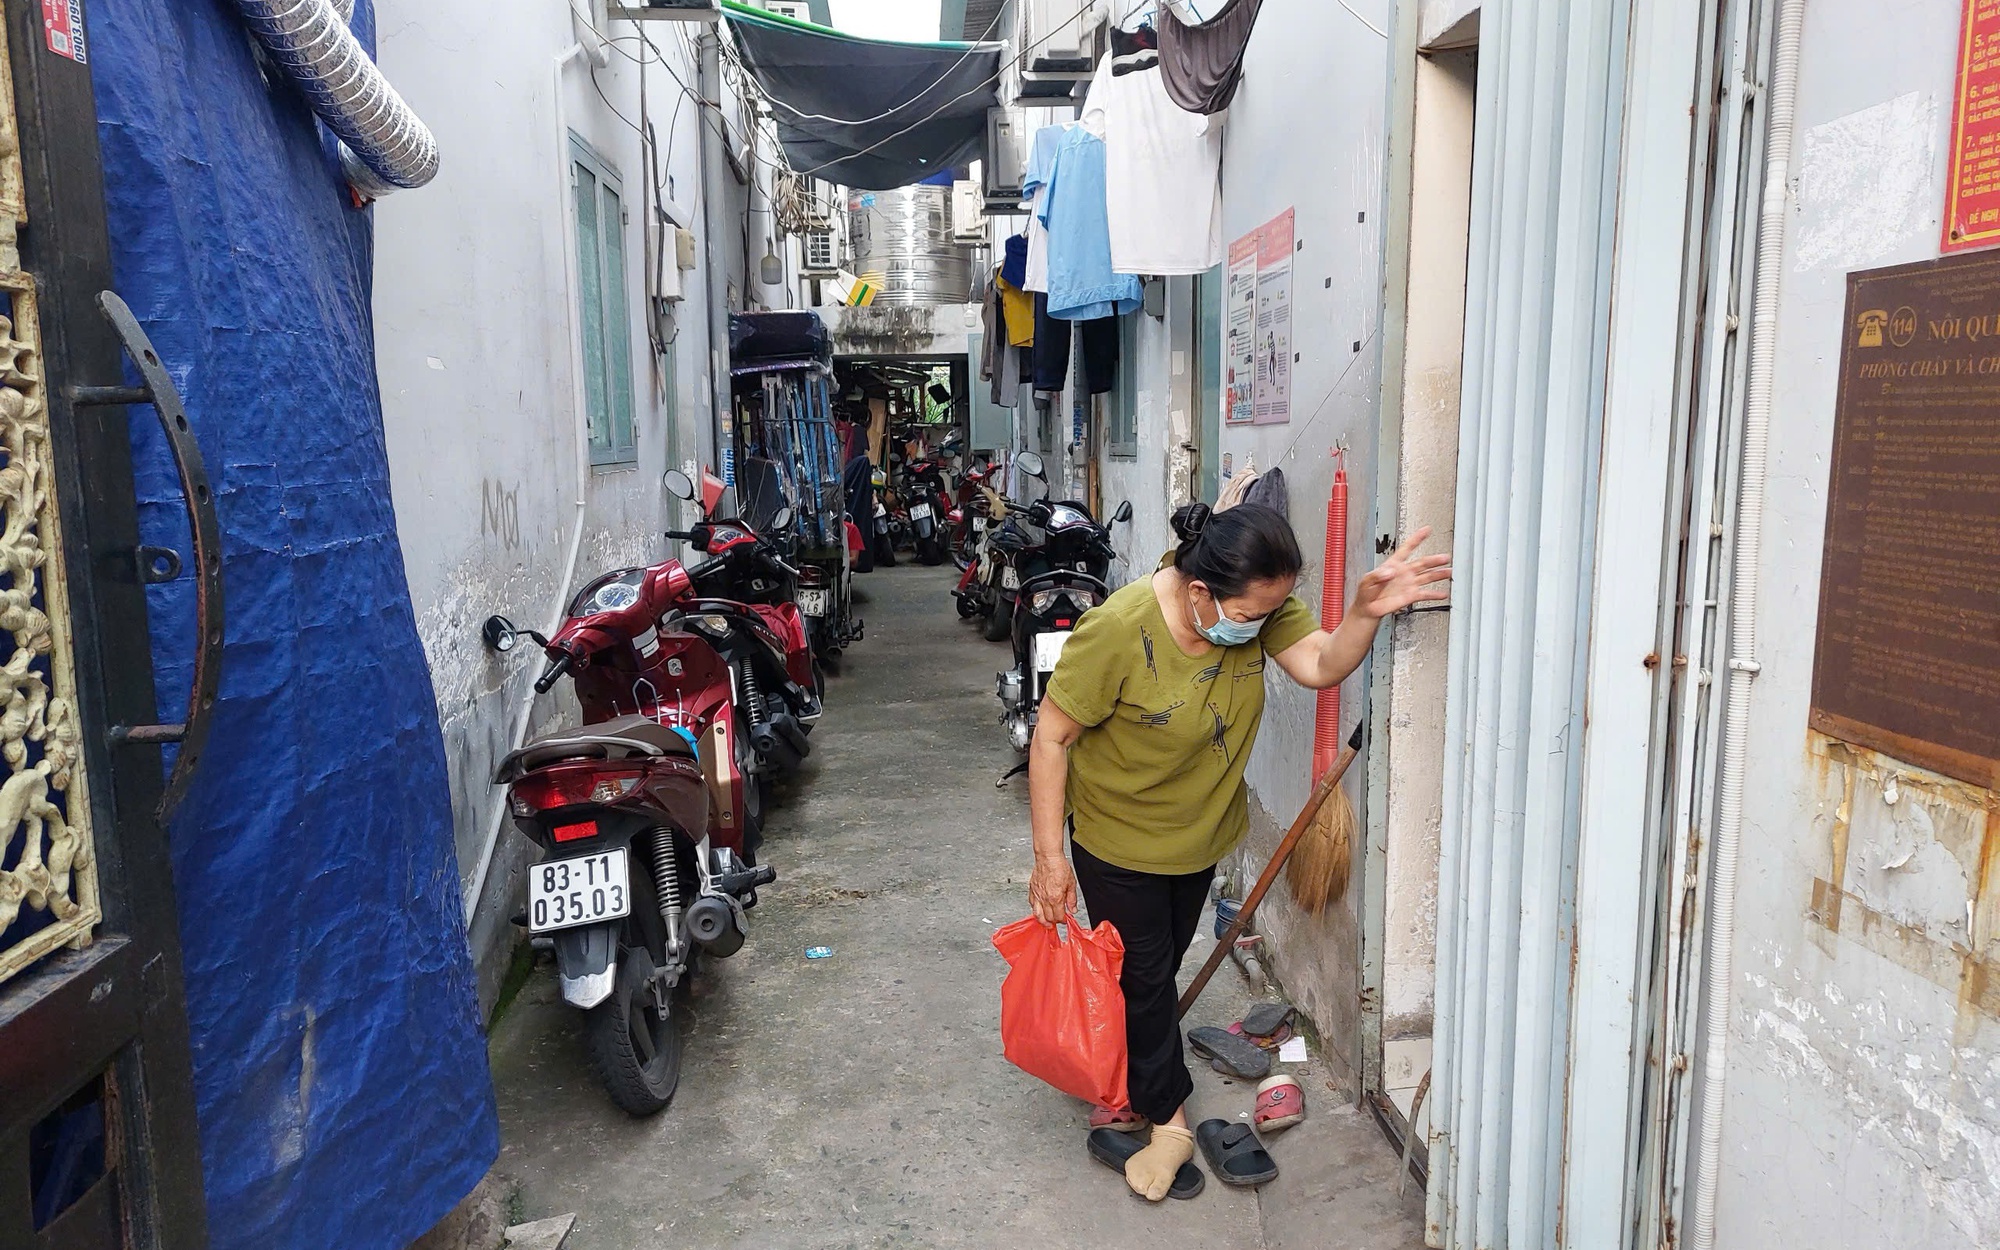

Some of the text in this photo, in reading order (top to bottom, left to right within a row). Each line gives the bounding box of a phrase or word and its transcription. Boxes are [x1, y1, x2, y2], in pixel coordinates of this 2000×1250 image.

[1975, 34, 1984, 47] 5.
[1970, 86, 1979, 98] 6.
[1966, 135, 1975, 148] 7.
[1893, 317, 1913, 336] 114
[1927, 313, 1962, 344] NỘI
[1955, 353, 1974, 374] VÀ
[543, 856, 610, 894] 83-T1
[534, 885, 624, 926] 035.03
